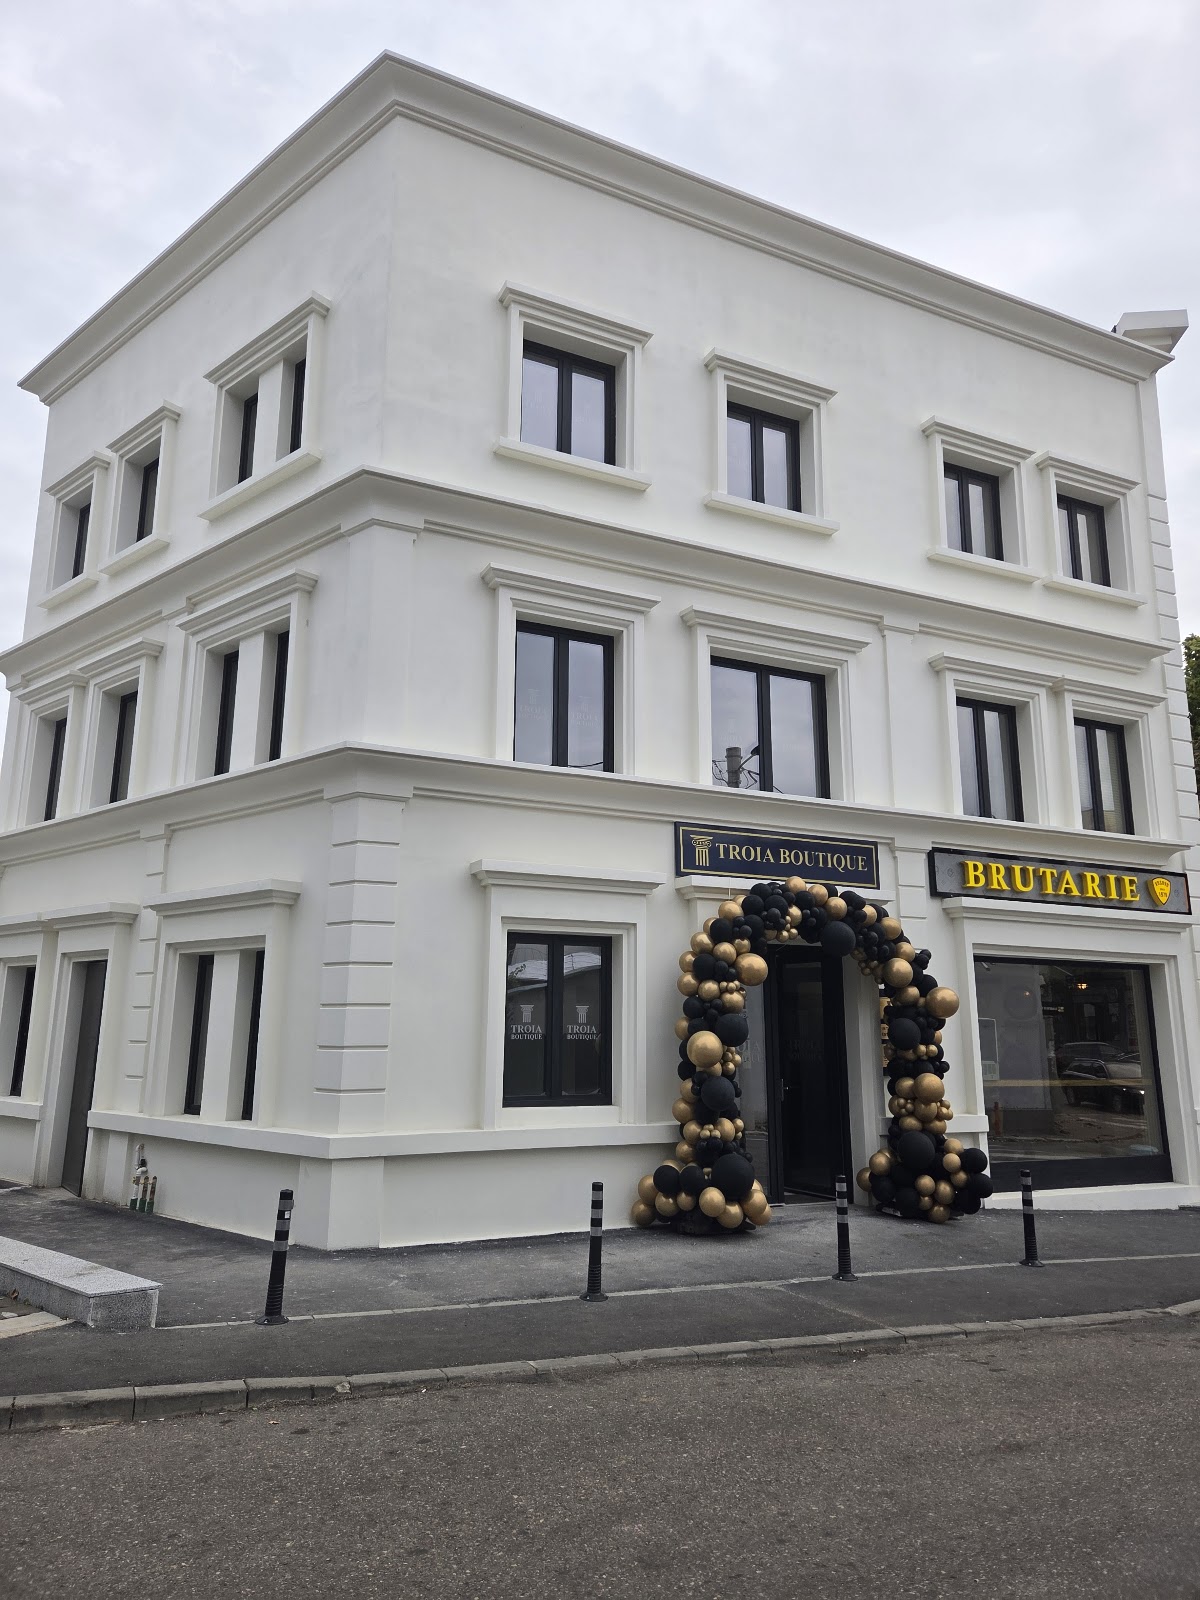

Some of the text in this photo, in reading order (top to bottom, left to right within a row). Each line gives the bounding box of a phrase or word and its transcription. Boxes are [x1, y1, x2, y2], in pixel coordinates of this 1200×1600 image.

[715, 843, 868, 873] TROIA BOUTIQUE
[962, 860, 1141, 901] BRUTARIE
[510, 1024, 542, 1033] TROIA
[566, 1024, 597, 1033] TROIA
